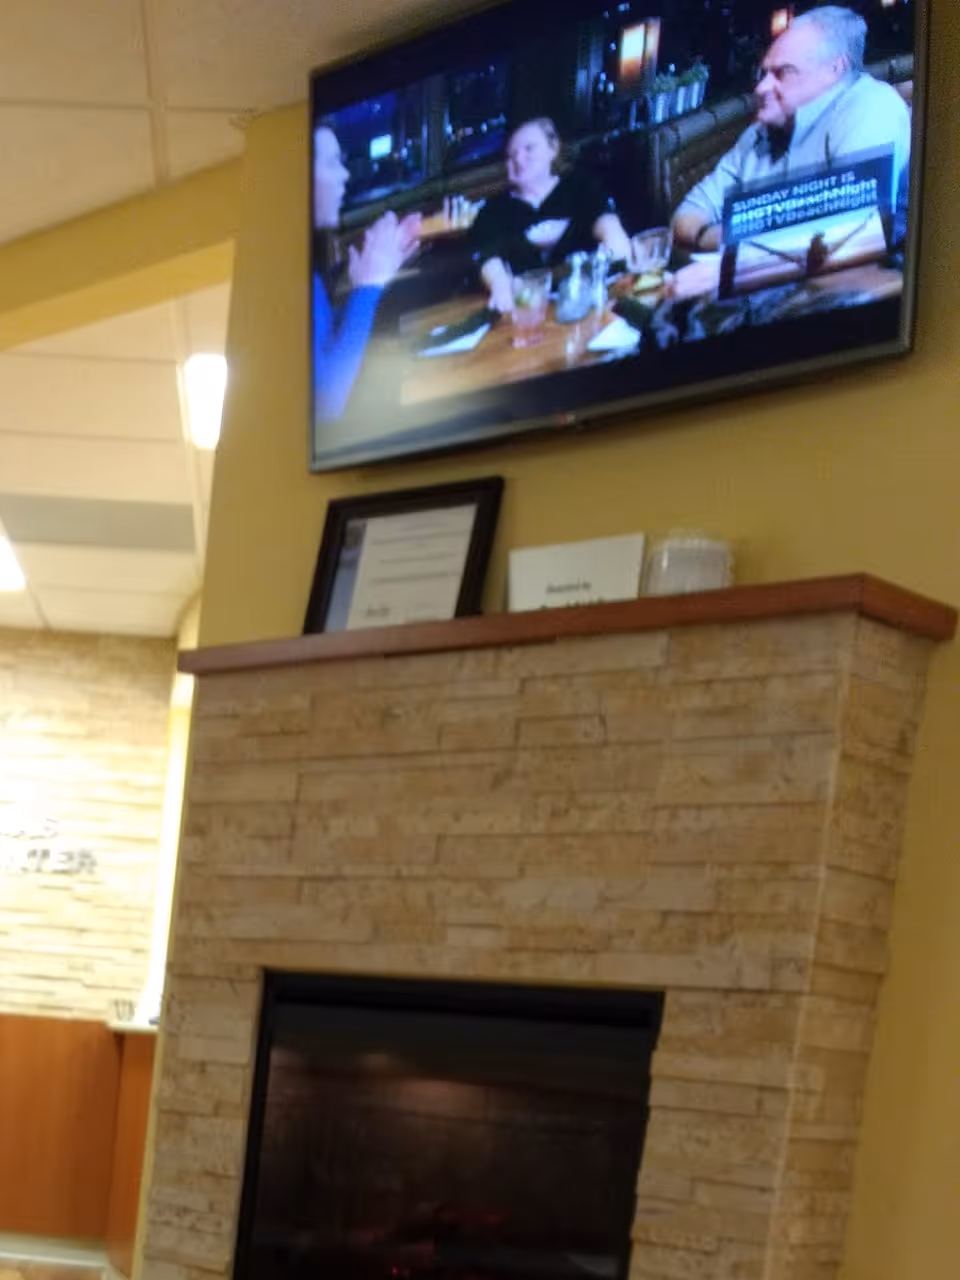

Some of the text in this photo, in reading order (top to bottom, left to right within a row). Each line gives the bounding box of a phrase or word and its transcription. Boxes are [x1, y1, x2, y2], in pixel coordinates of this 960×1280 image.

[732, 170, 855, 213] SUNDAY NIGHT IS
